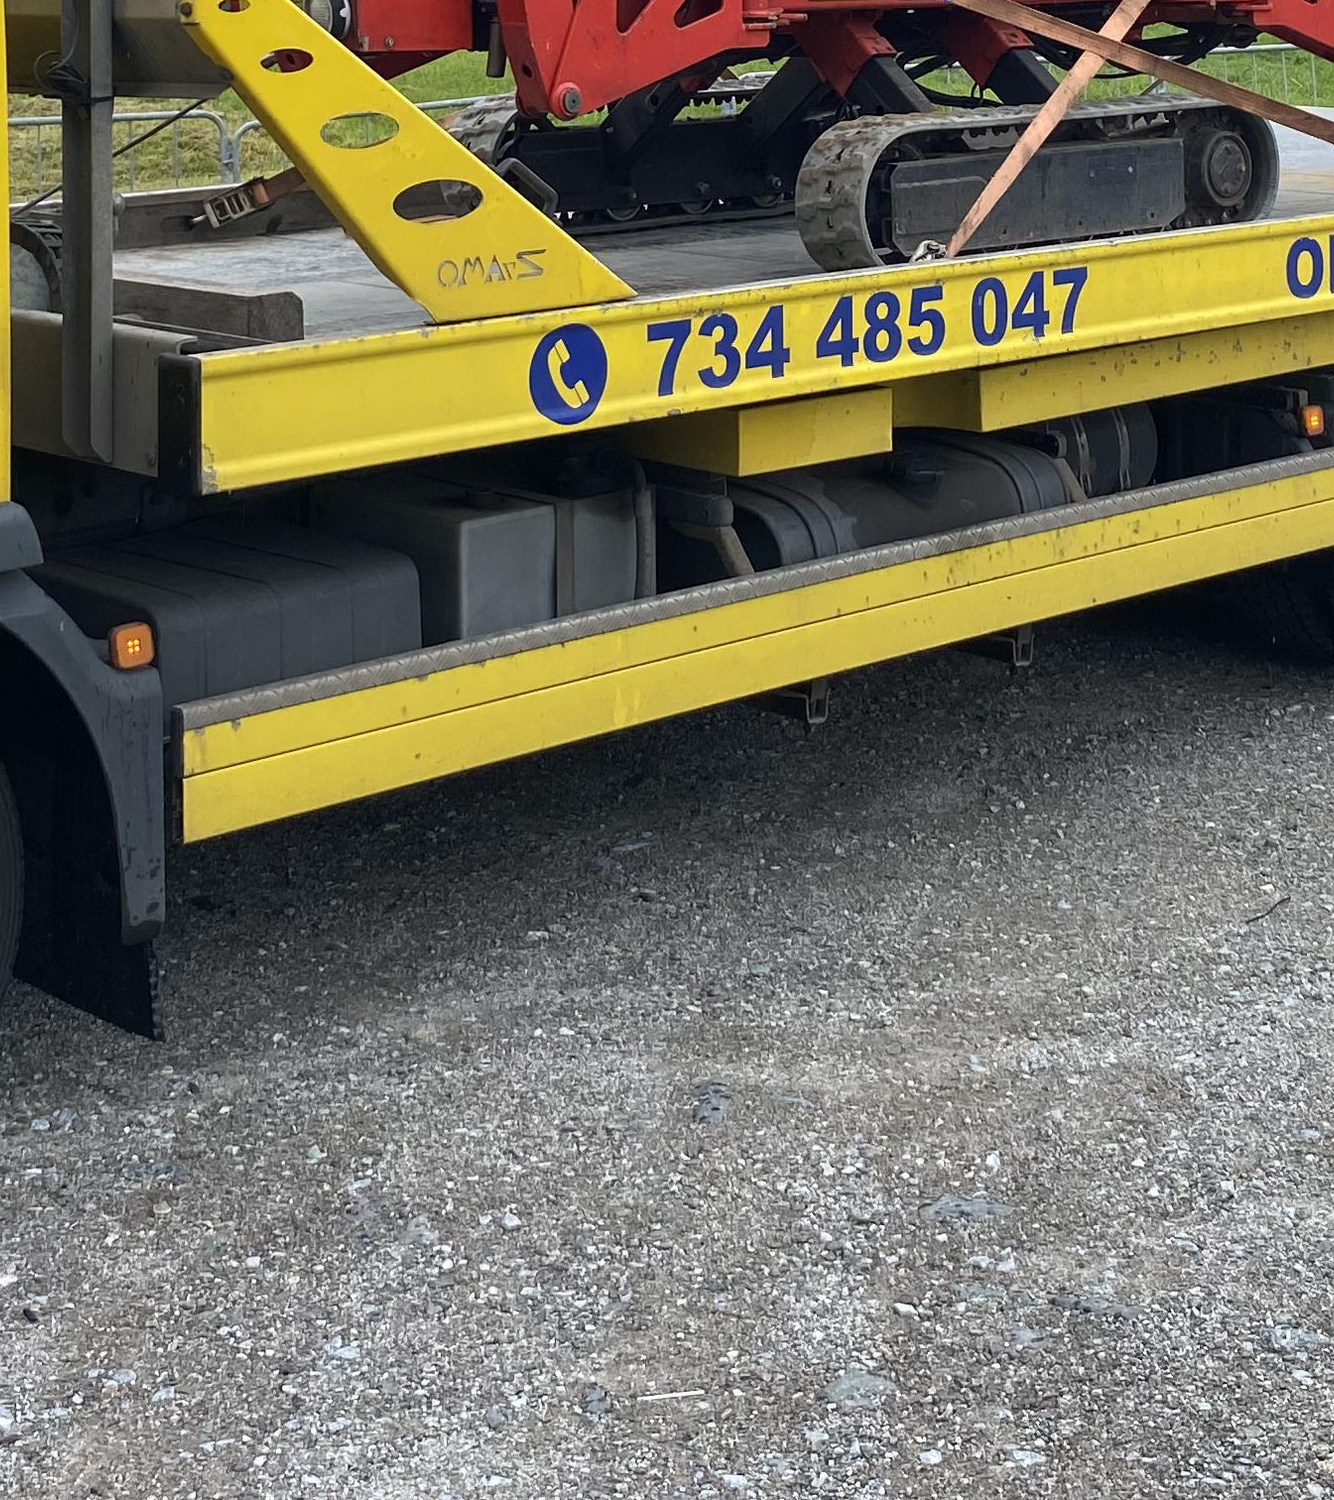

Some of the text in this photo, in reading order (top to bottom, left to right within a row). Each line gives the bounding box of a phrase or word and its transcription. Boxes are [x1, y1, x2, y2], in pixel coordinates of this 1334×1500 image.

[647, 267, 1088, 396] 734 485 047
